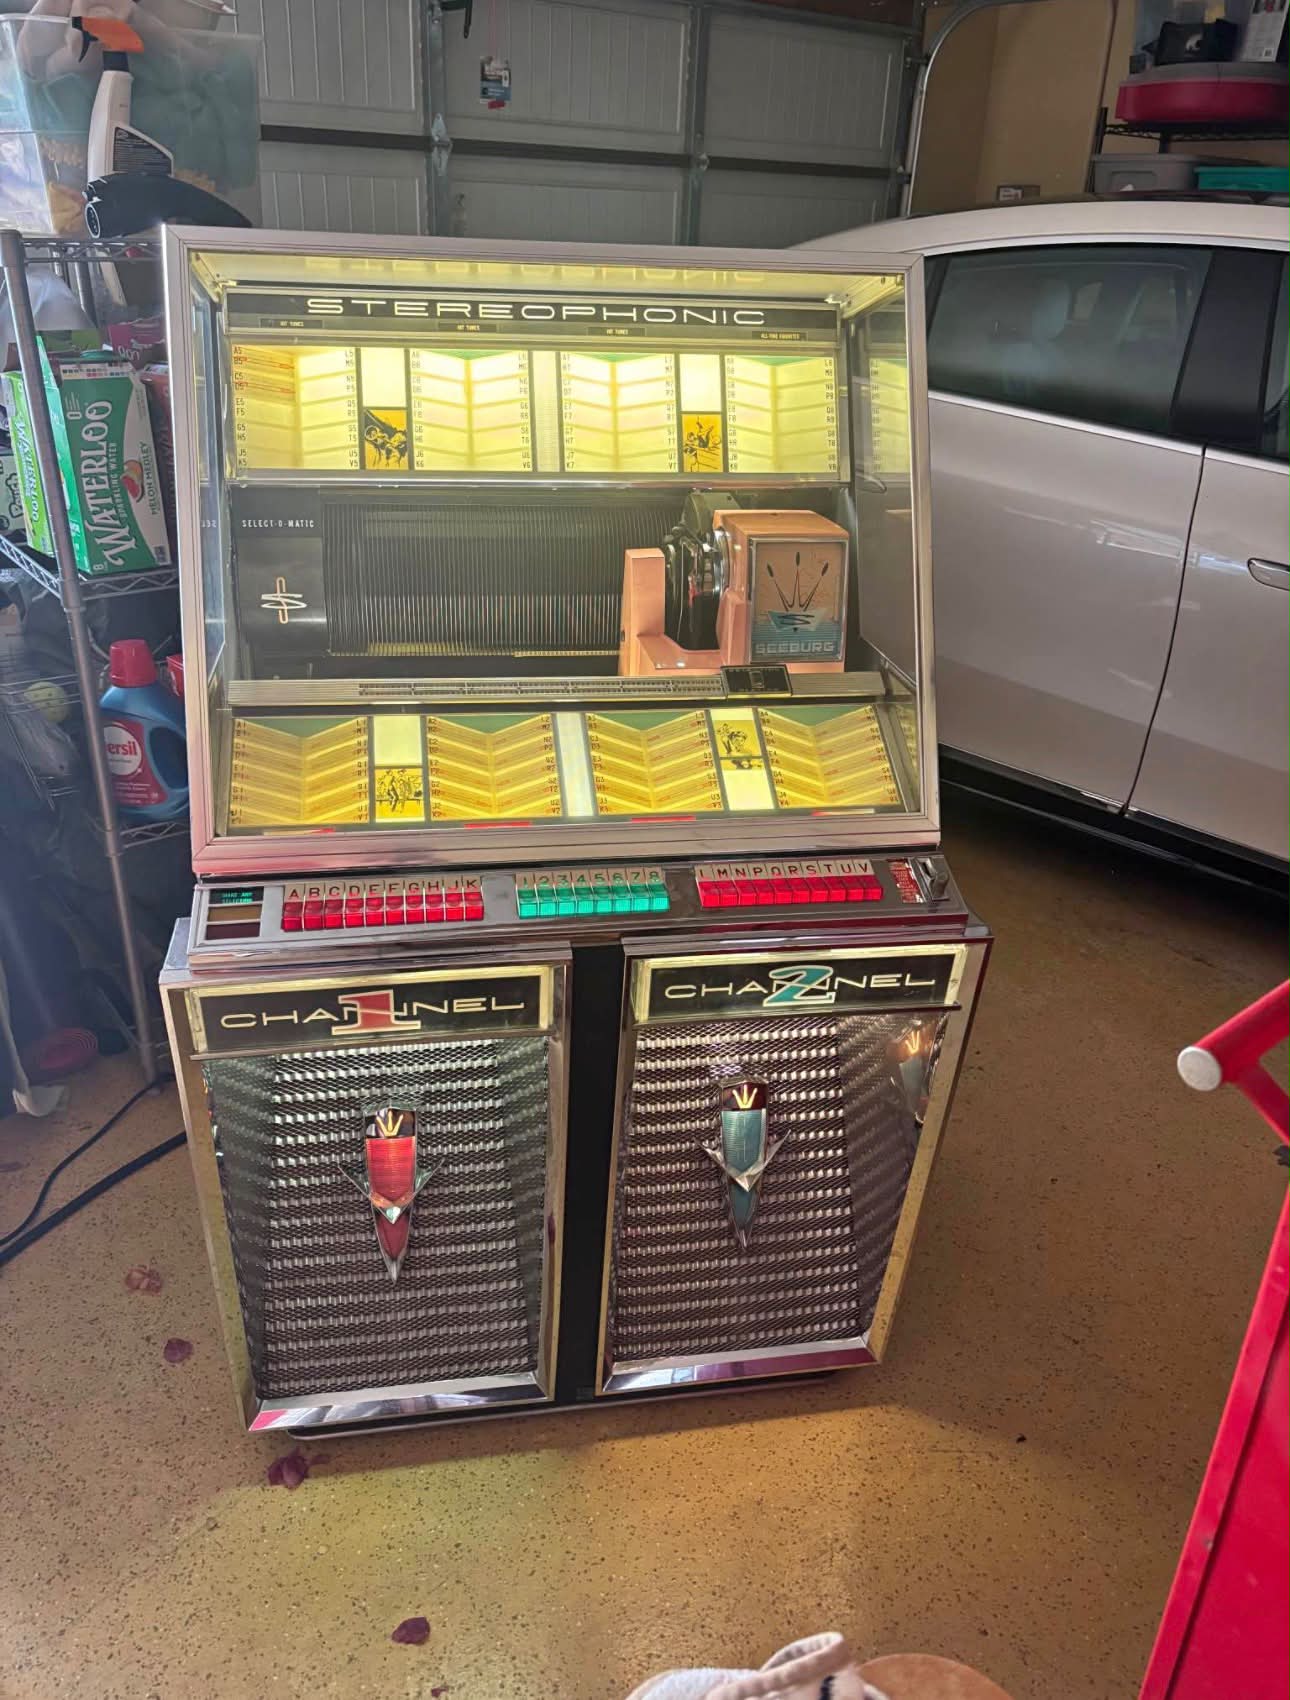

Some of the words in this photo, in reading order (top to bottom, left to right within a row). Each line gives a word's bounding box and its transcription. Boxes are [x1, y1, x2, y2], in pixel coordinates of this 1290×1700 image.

[307, 298, 765, 325] STEREOPHONIC
[108, 442, 118, 470] WATER
[140, 441, 153, 480] MEDLEY
[350, 460, 358, 468] V5
[81, 400, 137, 566] WATERLOO
[146, 482, 158, 514] MELON
[756, 641, 836, 653] SEEBURG
[106, 741, 138, 756] ersil
[523, 877, 528, 887] 1
[539, 876, 550, 886] 2
[558, 875, 569, 886] 3
[576, 874, 586, 884] 4
[595, 874, 605, 884] 5
[613, 873, 623, 883] 6
[631, 872, 640, 882] 7
[649, 871, 660, 882] 8
[718, 869, 728, 877] M
[736, 868, 746, 876] N
[789, 866, 798, 874] R
[807, 865, 816, 874] S
[824, 864, 832, 872] T
[841, 864, 851, 873] U
[858, 863, 868, 872] V
[289, 889, 299, 898] A
[309, 888, 320, 897] B
[329, 886, 340, 896] C
[349, 885, 360, 895] D
[369, 884, 379, 894] E
[389, 883, 399, 893] F
[408, 882, 419, 892] G
[428, 881, 438, 890] H
[466, 879, 477, 889] K
[665, 973, 935, 999] CHANNEL
[763, 965, 835, 1007] 2
[221, 994, 525, 1028] CHANNEL
[332, 990, 420, 1035] 1
